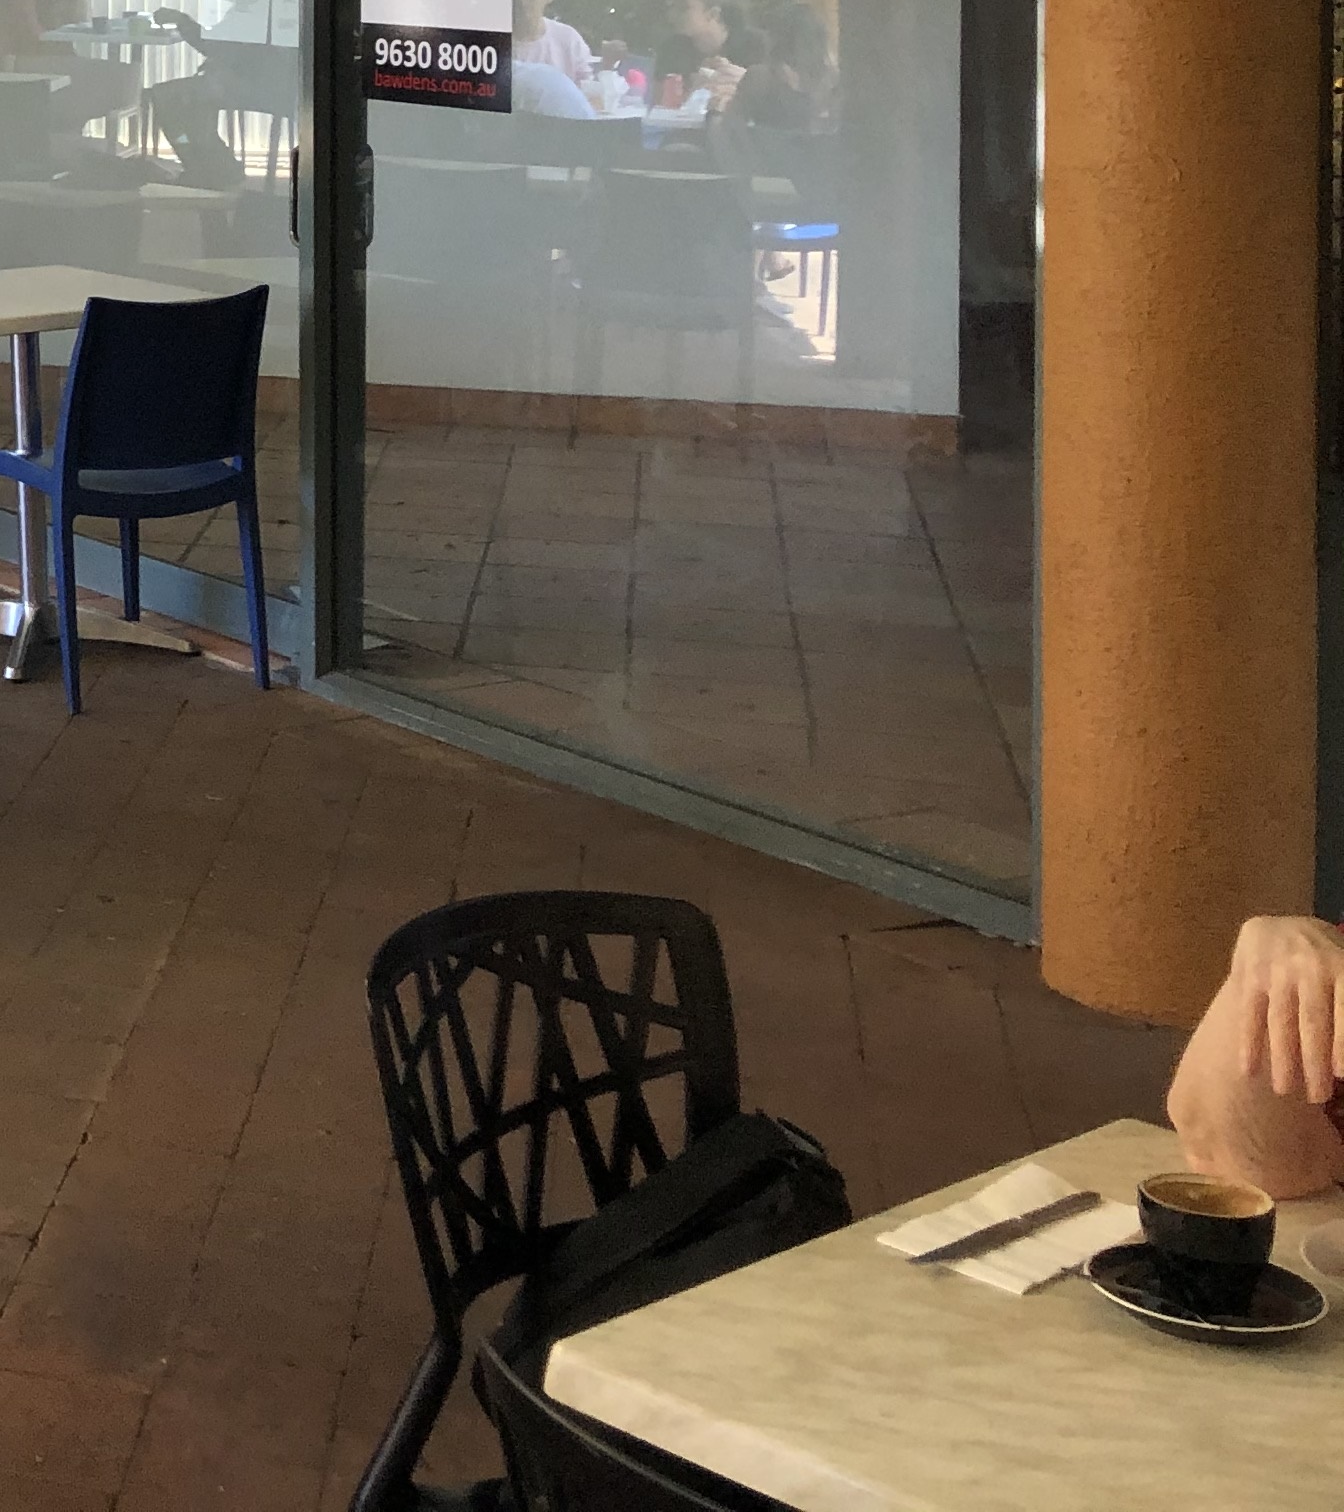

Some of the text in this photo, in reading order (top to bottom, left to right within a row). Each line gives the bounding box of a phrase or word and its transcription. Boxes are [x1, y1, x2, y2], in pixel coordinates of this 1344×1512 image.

[374, 37, 498, 75] 9630 8000
[374, 68, 497, 97] bawdens.com.au
